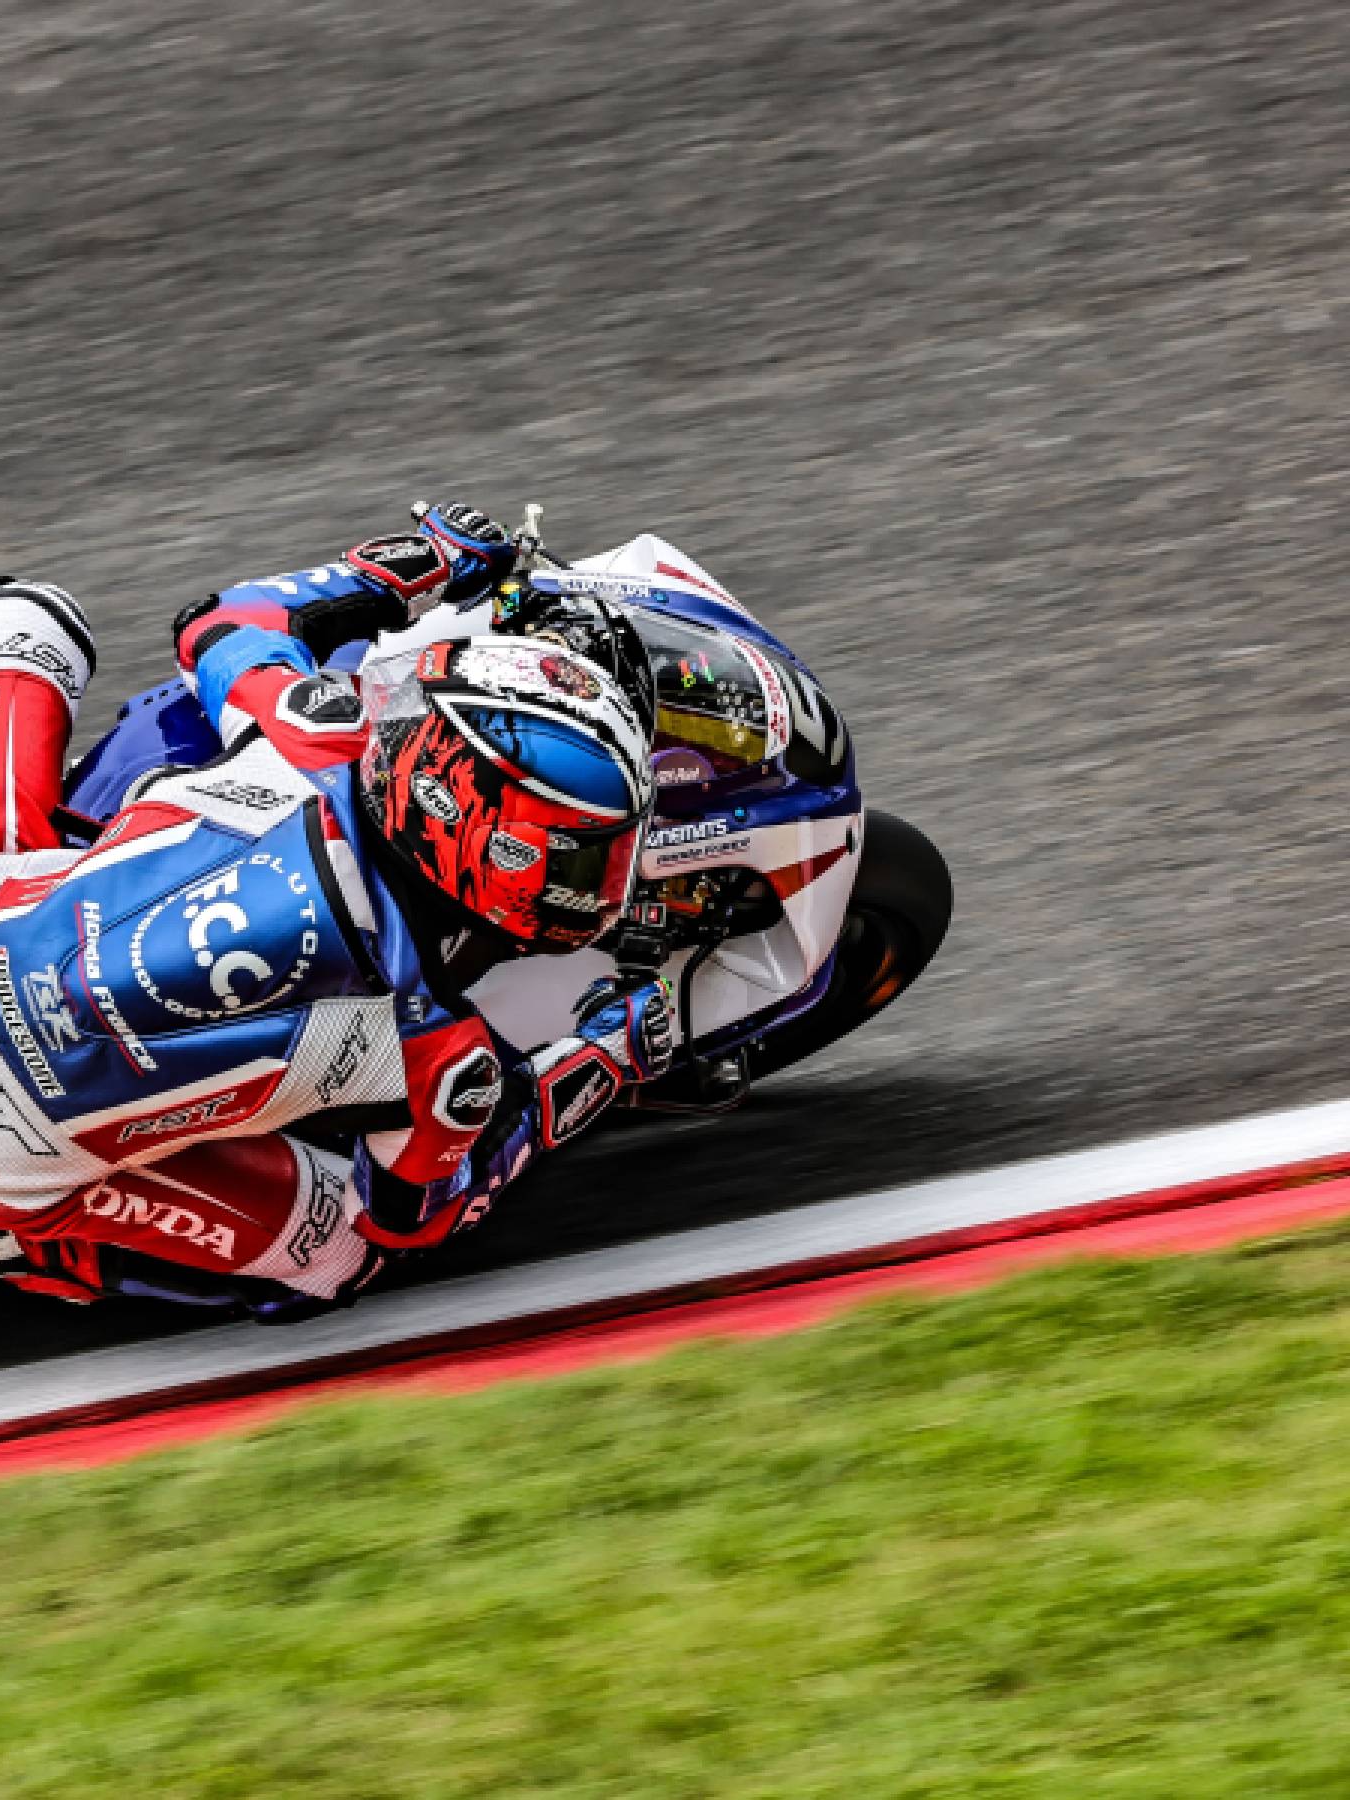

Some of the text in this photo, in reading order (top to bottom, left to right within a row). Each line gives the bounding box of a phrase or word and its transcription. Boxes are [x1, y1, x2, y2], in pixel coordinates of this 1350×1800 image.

[83, 901, 158, 1071] Honda France
[182, 866, 275, 1010] F.C.C.
[83, 1184, 237, 1261] ONDA
